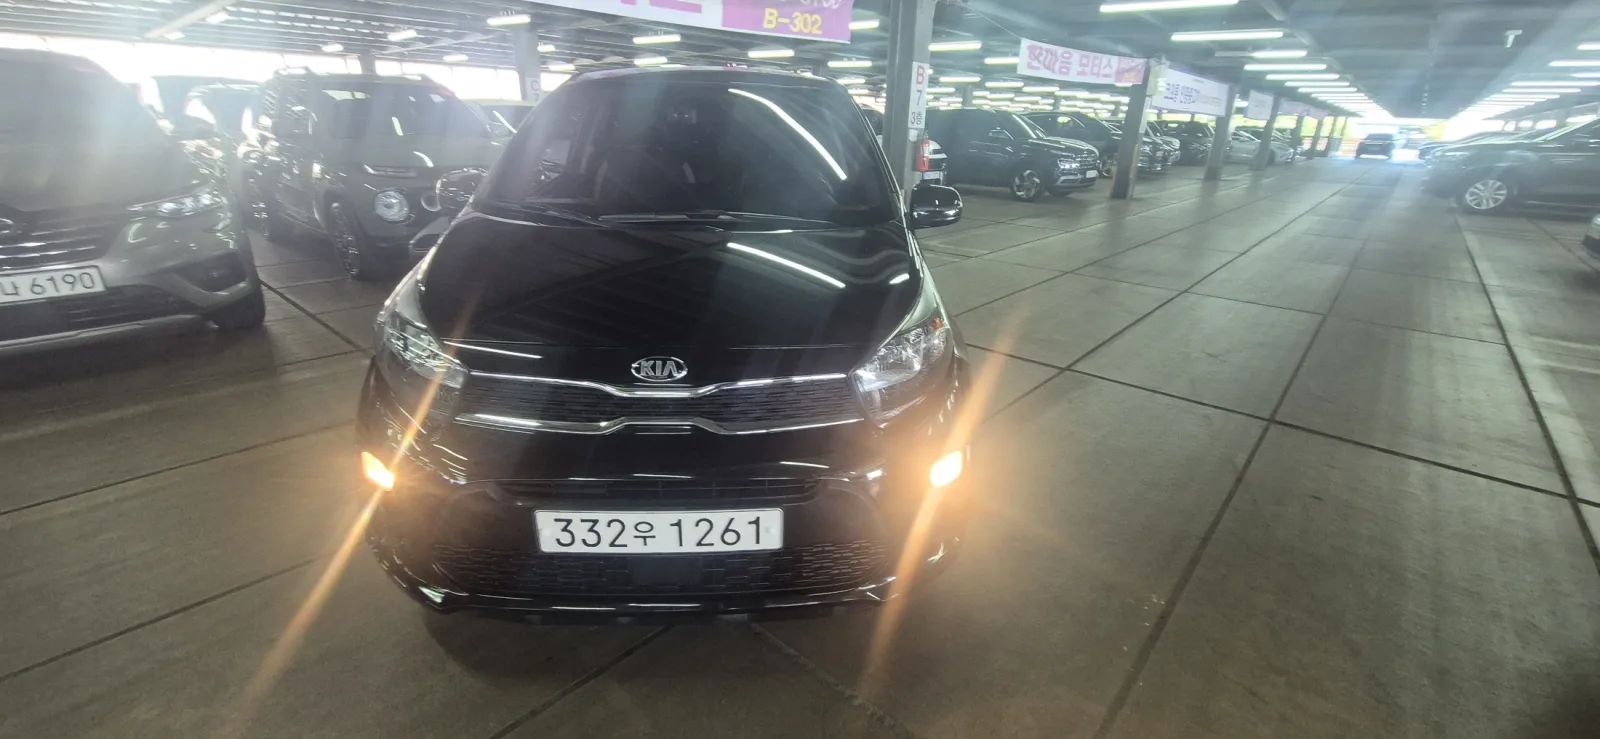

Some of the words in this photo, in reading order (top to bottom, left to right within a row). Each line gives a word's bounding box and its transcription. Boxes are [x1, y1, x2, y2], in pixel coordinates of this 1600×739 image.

[763, 7, 823, 35] B-302
[916, 65, 925, 85] B
[1076, 53, 1113, 79] 모터스
[916, 89, 923, 106] 7
[910, 111, 923, 125] 3층
[30, 271, 95, 296] 6190
[640, 360, 678, 377] KIA
[553, 518, 657, 548] 332우
[669, 516, 761, 547] 1261
